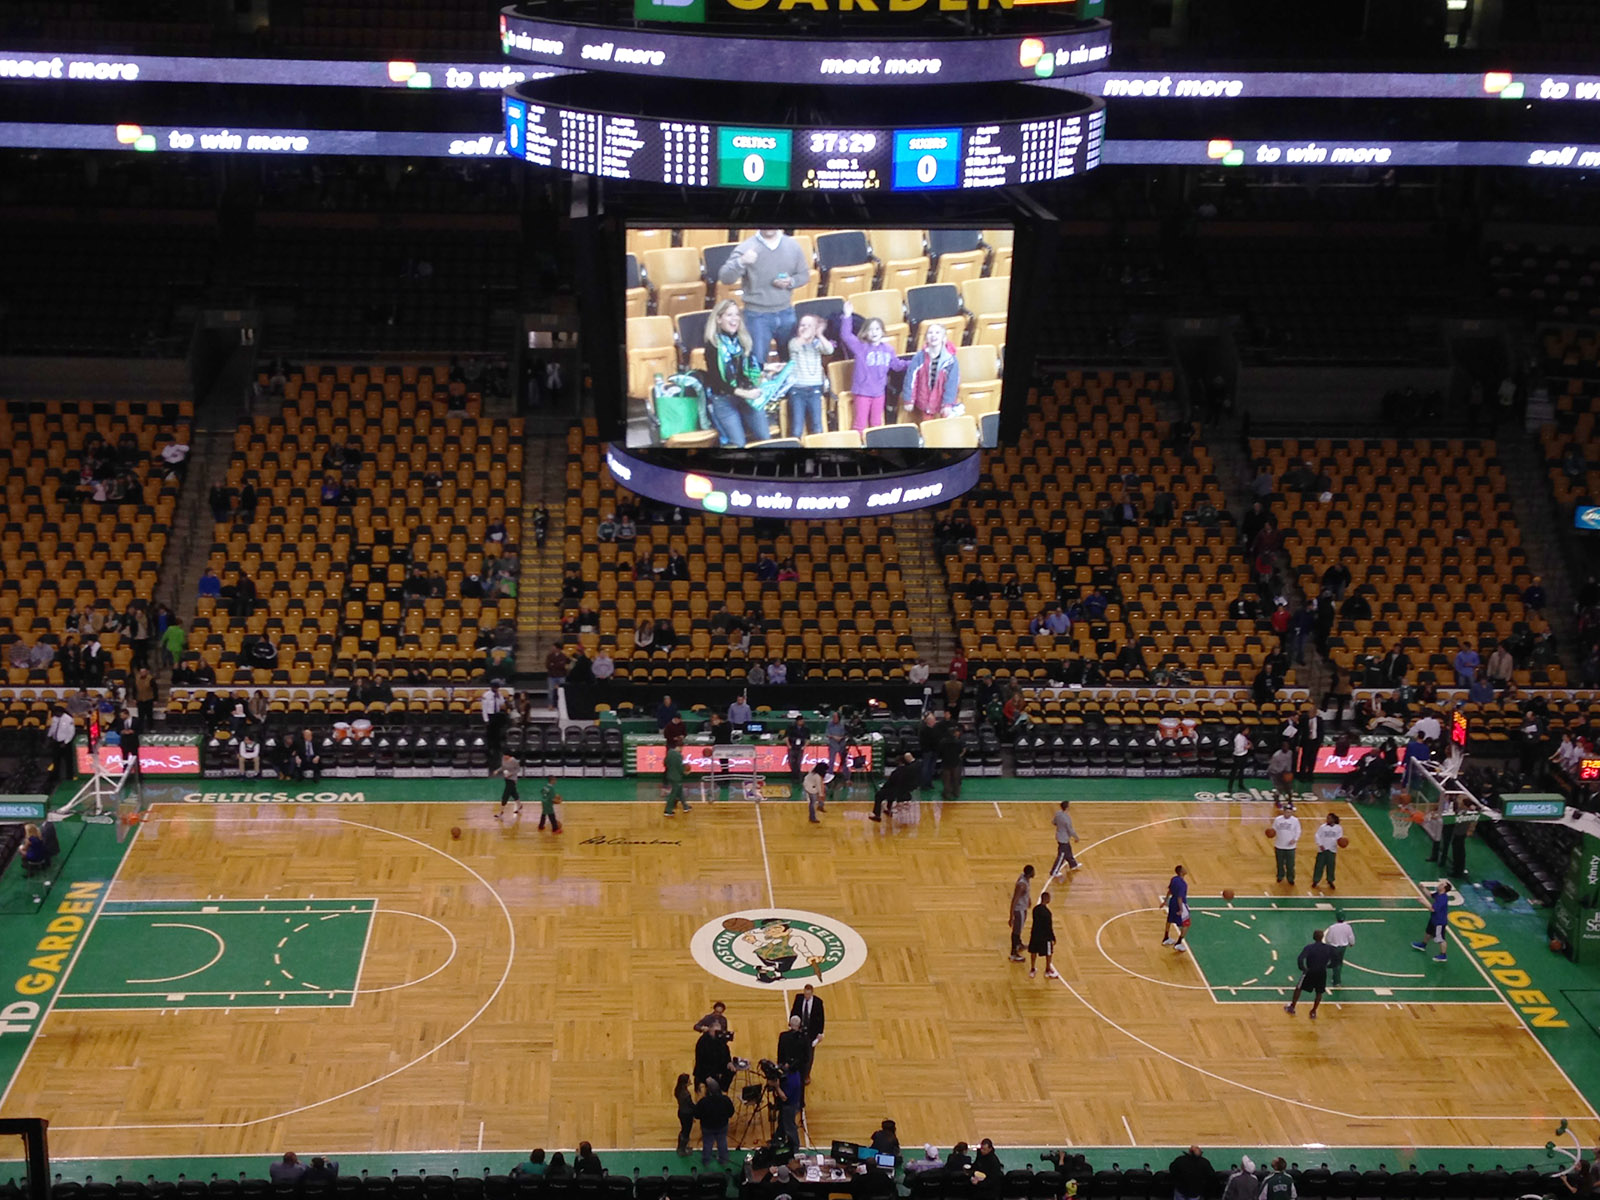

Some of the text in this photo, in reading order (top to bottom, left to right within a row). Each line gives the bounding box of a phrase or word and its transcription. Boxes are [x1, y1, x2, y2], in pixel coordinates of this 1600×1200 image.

[614, 47, 666, 65] more
[820, 56, 942, 74] meet more
[68, 60, 140, 80] more
[446, 67, 474, 88] to
[1103, 76, 1243, 97] meet more
[1540, 78, 1570, 99] to
[169, 129, 309, 151] to win more
[732, 136, 777, 150] CELTICS
[810, 133, 877, 153] 37:29
[1256, 143, 1392, 162] to win more
[743, 153, 765, 182] 0
[917, 154, 938, 183] 0
[731, 490, 851, 509] to win more
[902, 482, 944, 501] more
[143, 734, 198, 743] xfinity
[183, 792, 366, 803] CELTICS.COM
[716, 931, 746, 970] BOSTON
[807, 925, 843, 963] CELTICS
[0, 881, 105, 1036] TD GARDEN
[1447, 910, 1570, 1028] GARDEN
